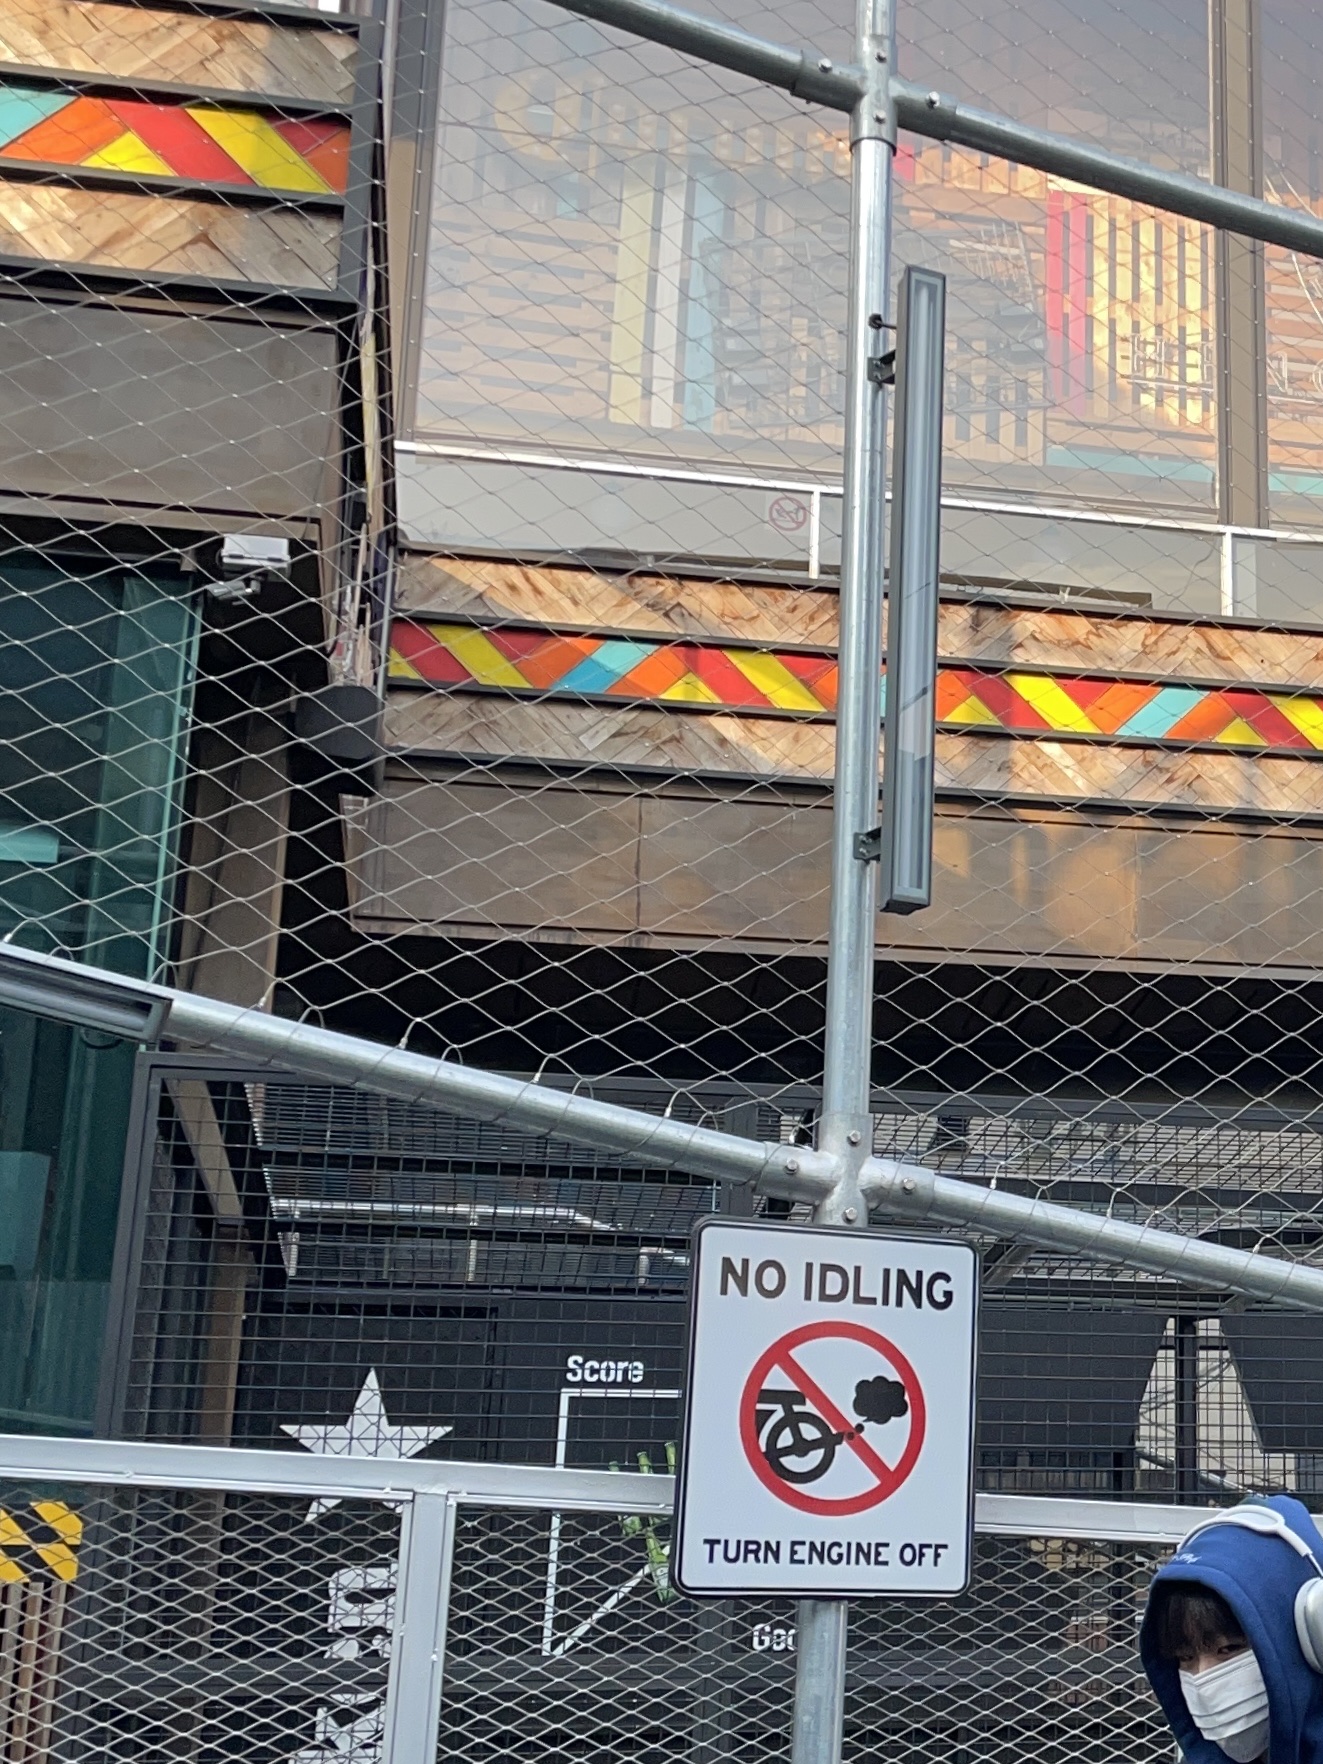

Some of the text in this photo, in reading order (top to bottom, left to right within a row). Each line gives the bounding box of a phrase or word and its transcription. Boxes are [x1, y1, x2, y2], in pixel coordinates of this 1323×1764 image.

[720, 1256, 954, 1312] NO IDLING
[566, 1355, 645, 1383] Score
[702, 1538, 949, 1567] TURN ENGINE OFF
